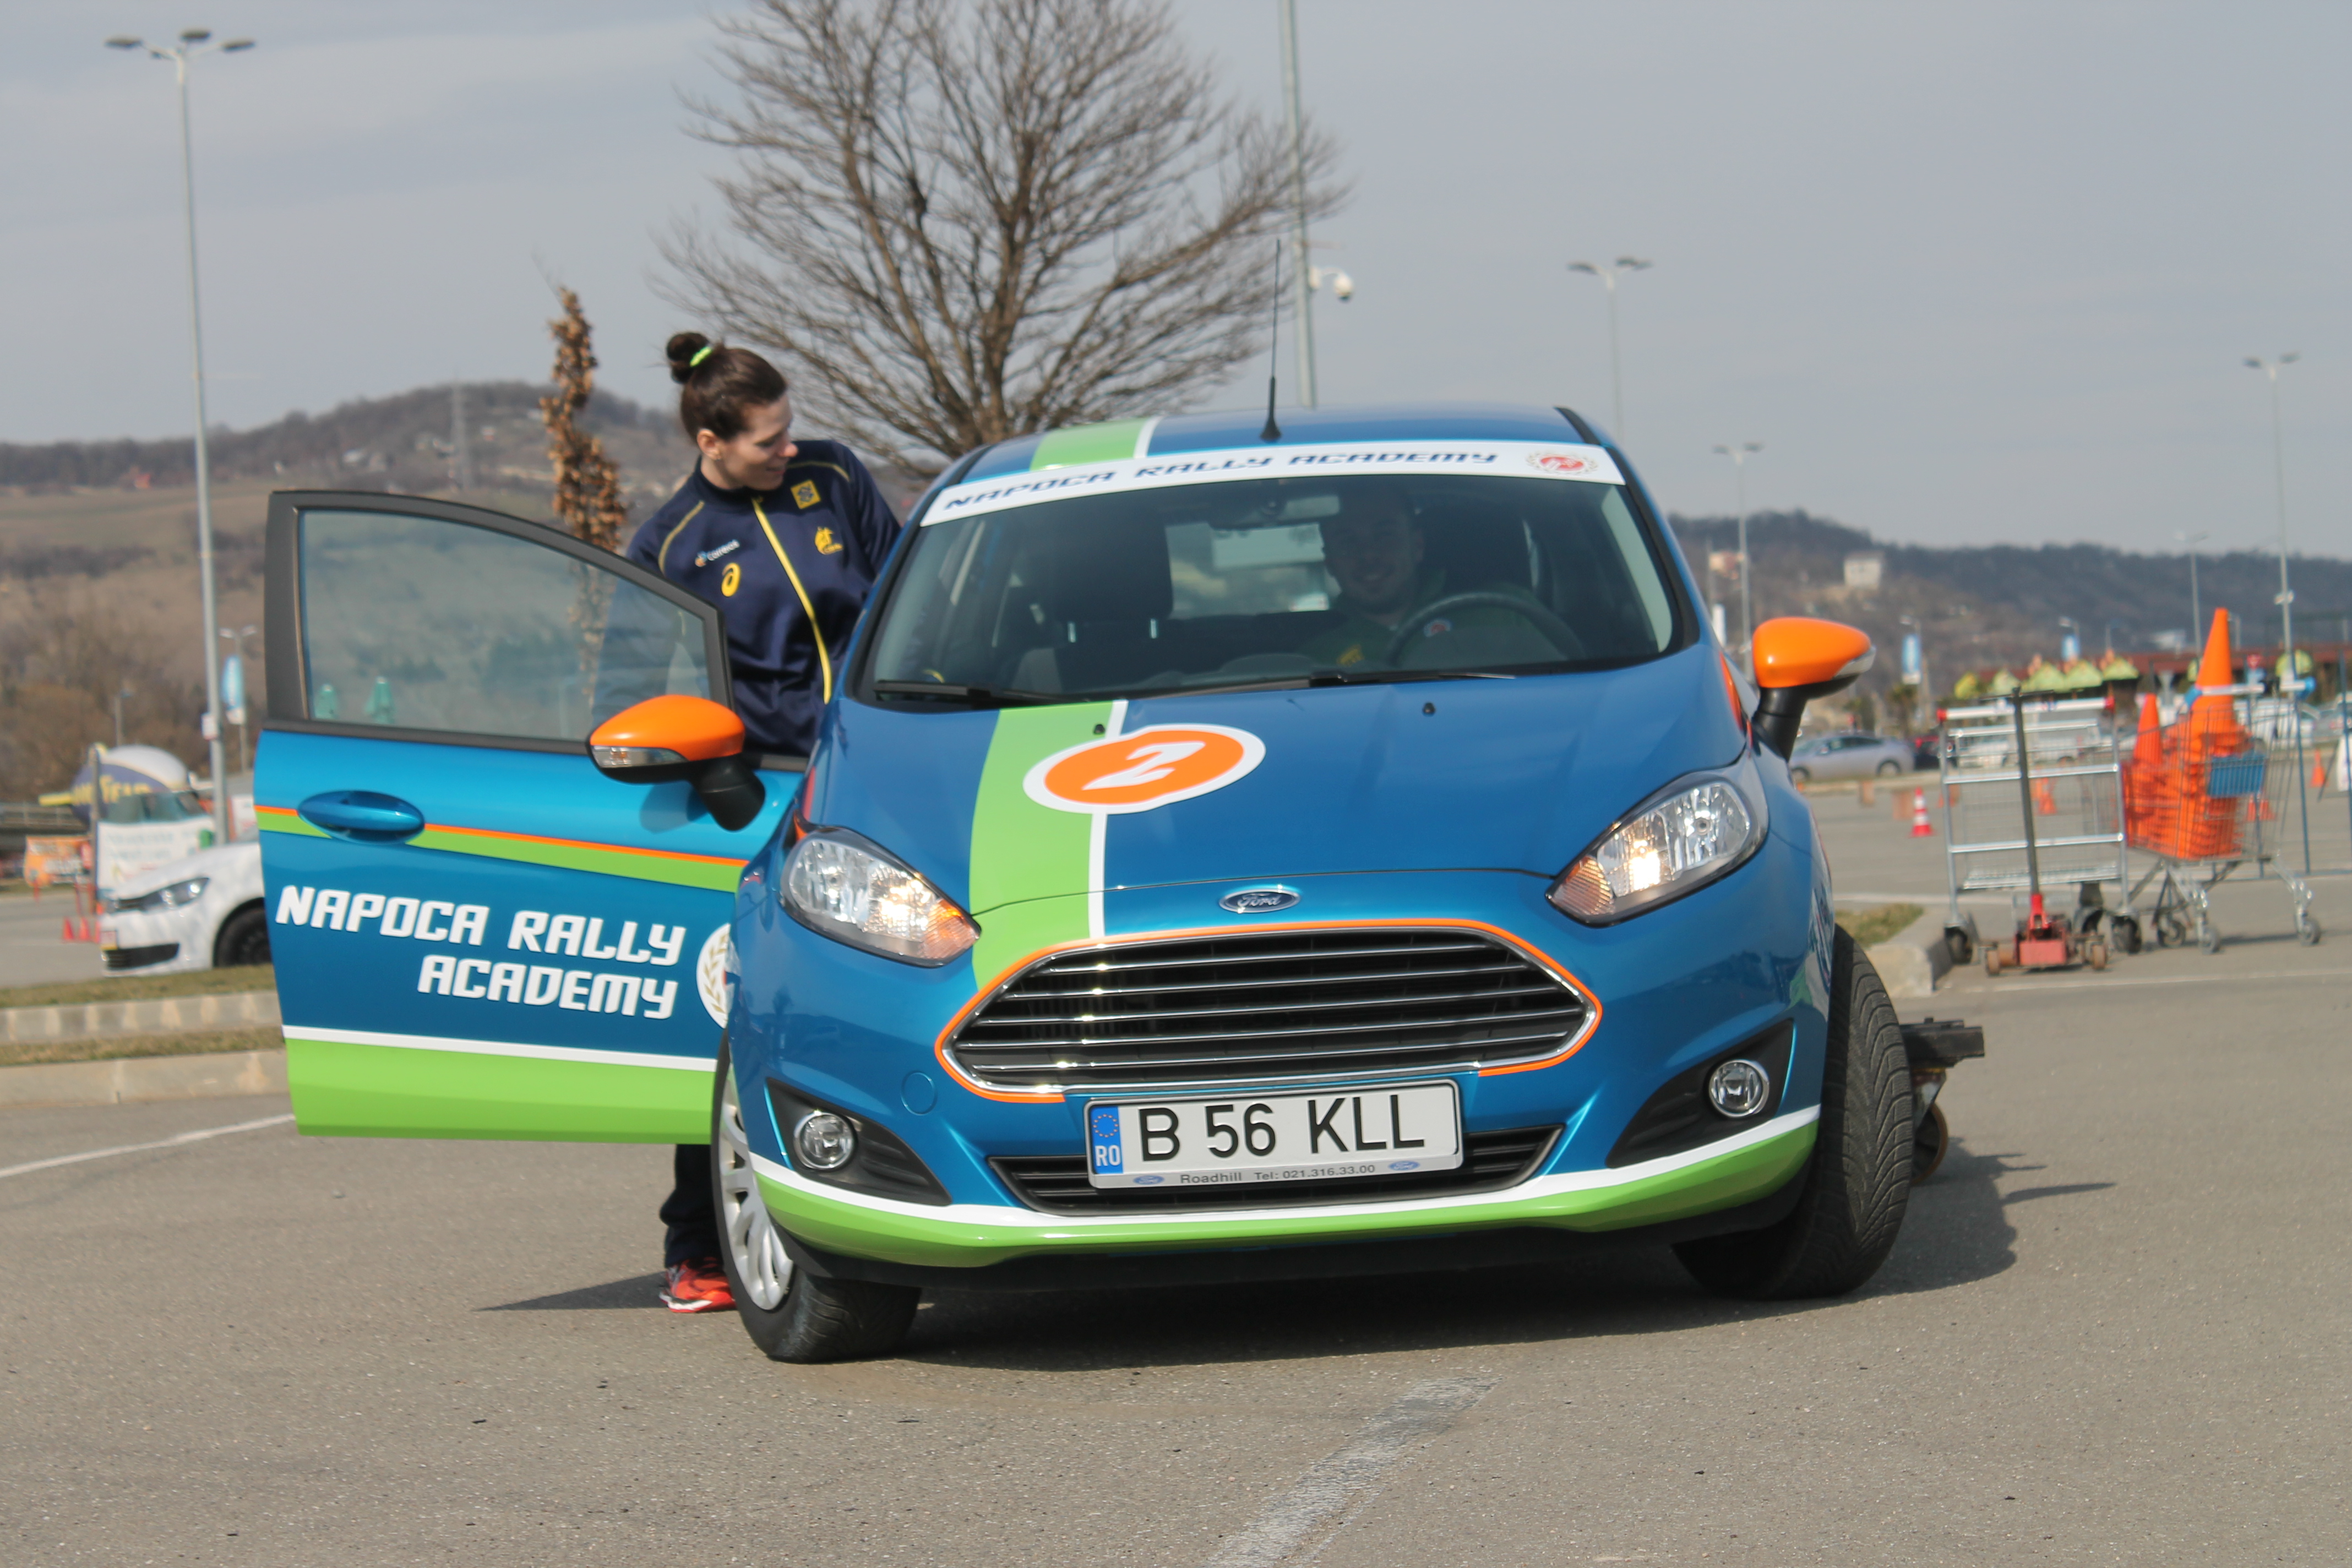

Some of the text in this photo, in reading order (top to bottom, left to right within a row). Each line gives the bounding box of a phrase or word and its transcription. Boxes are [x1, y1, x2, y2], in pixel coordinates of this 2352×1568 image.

[945, 453, 1498, 510] NAPOCA RALLY ACADEMY
[276, 885, 687, 966] NAPOCA RALLY
[1237, 893, 1282, 907] Ford
[417, 955, 678, 1019] ACADEMY
[1095, 1145, 1121, 1166] RO
[1139, 1095, 1424, 1162] B 56 KLL
[1180, 1172, 1242, 1184] Roadhill
[1254, 1172, 1279, 1180] Tel:
[1283, 1164, 1375, 1179] 021.316.33.00
